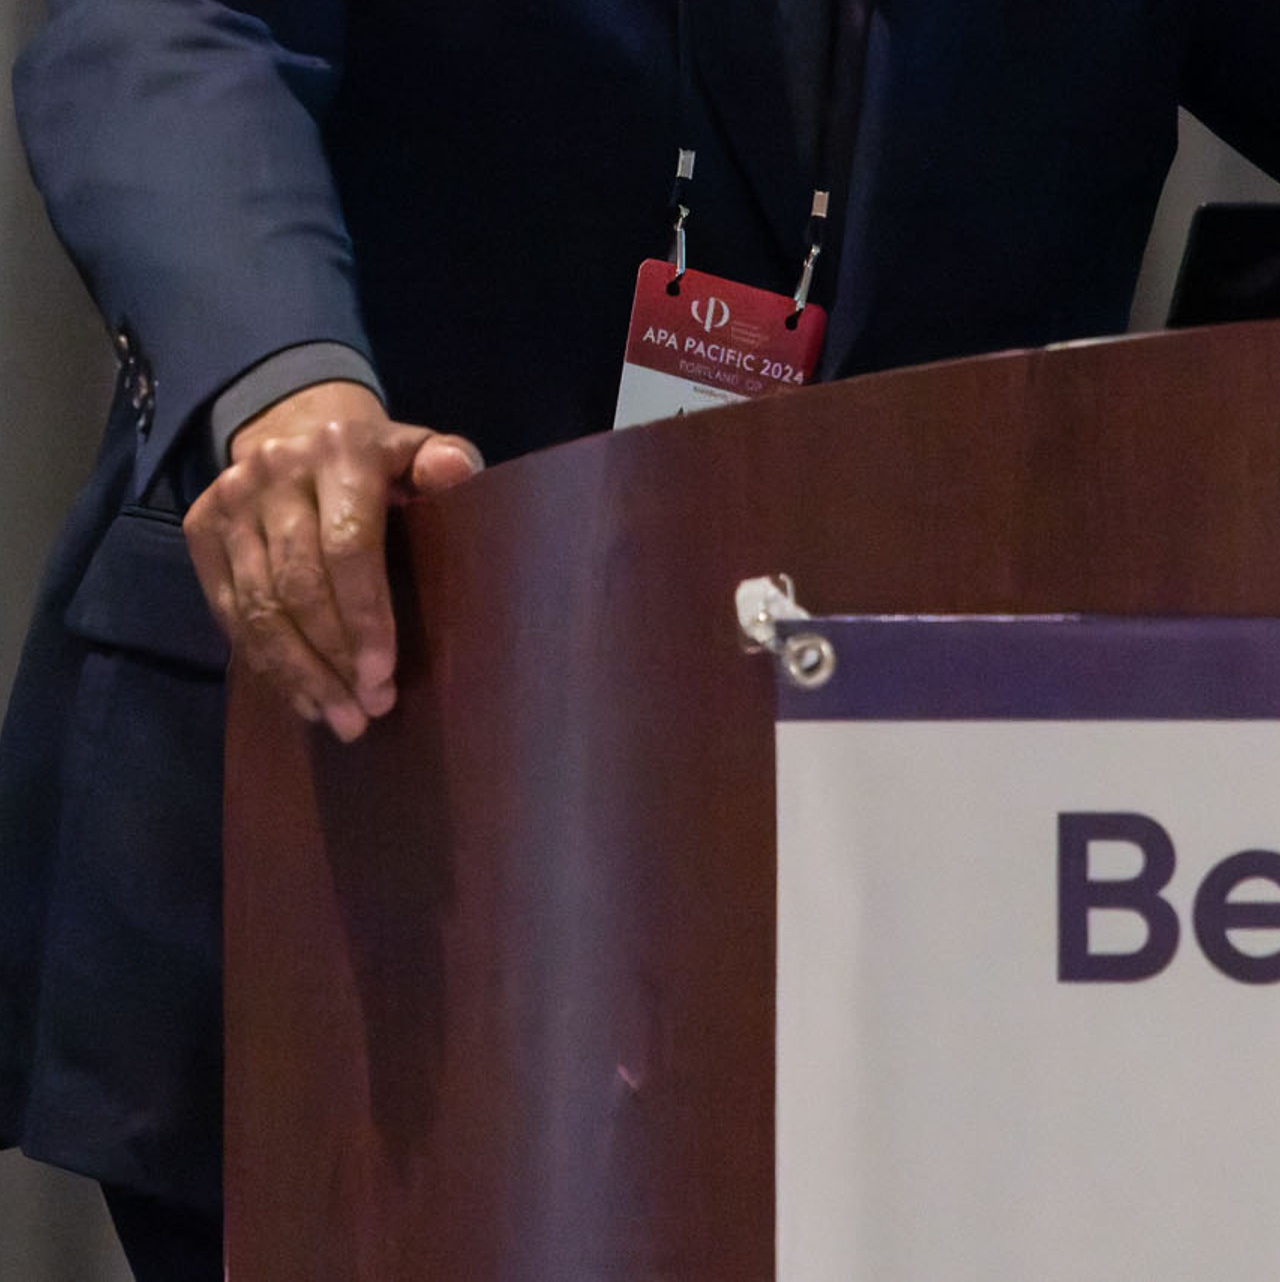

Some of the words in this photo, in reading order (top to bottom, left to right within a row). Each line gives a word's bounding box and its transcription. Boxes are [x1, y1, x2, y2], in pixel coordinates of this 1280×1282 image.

[642, 326, 678, 350] APA
[684, 336, 755, 371] PACIFIC
[759, 358, 804, 385] 2024
